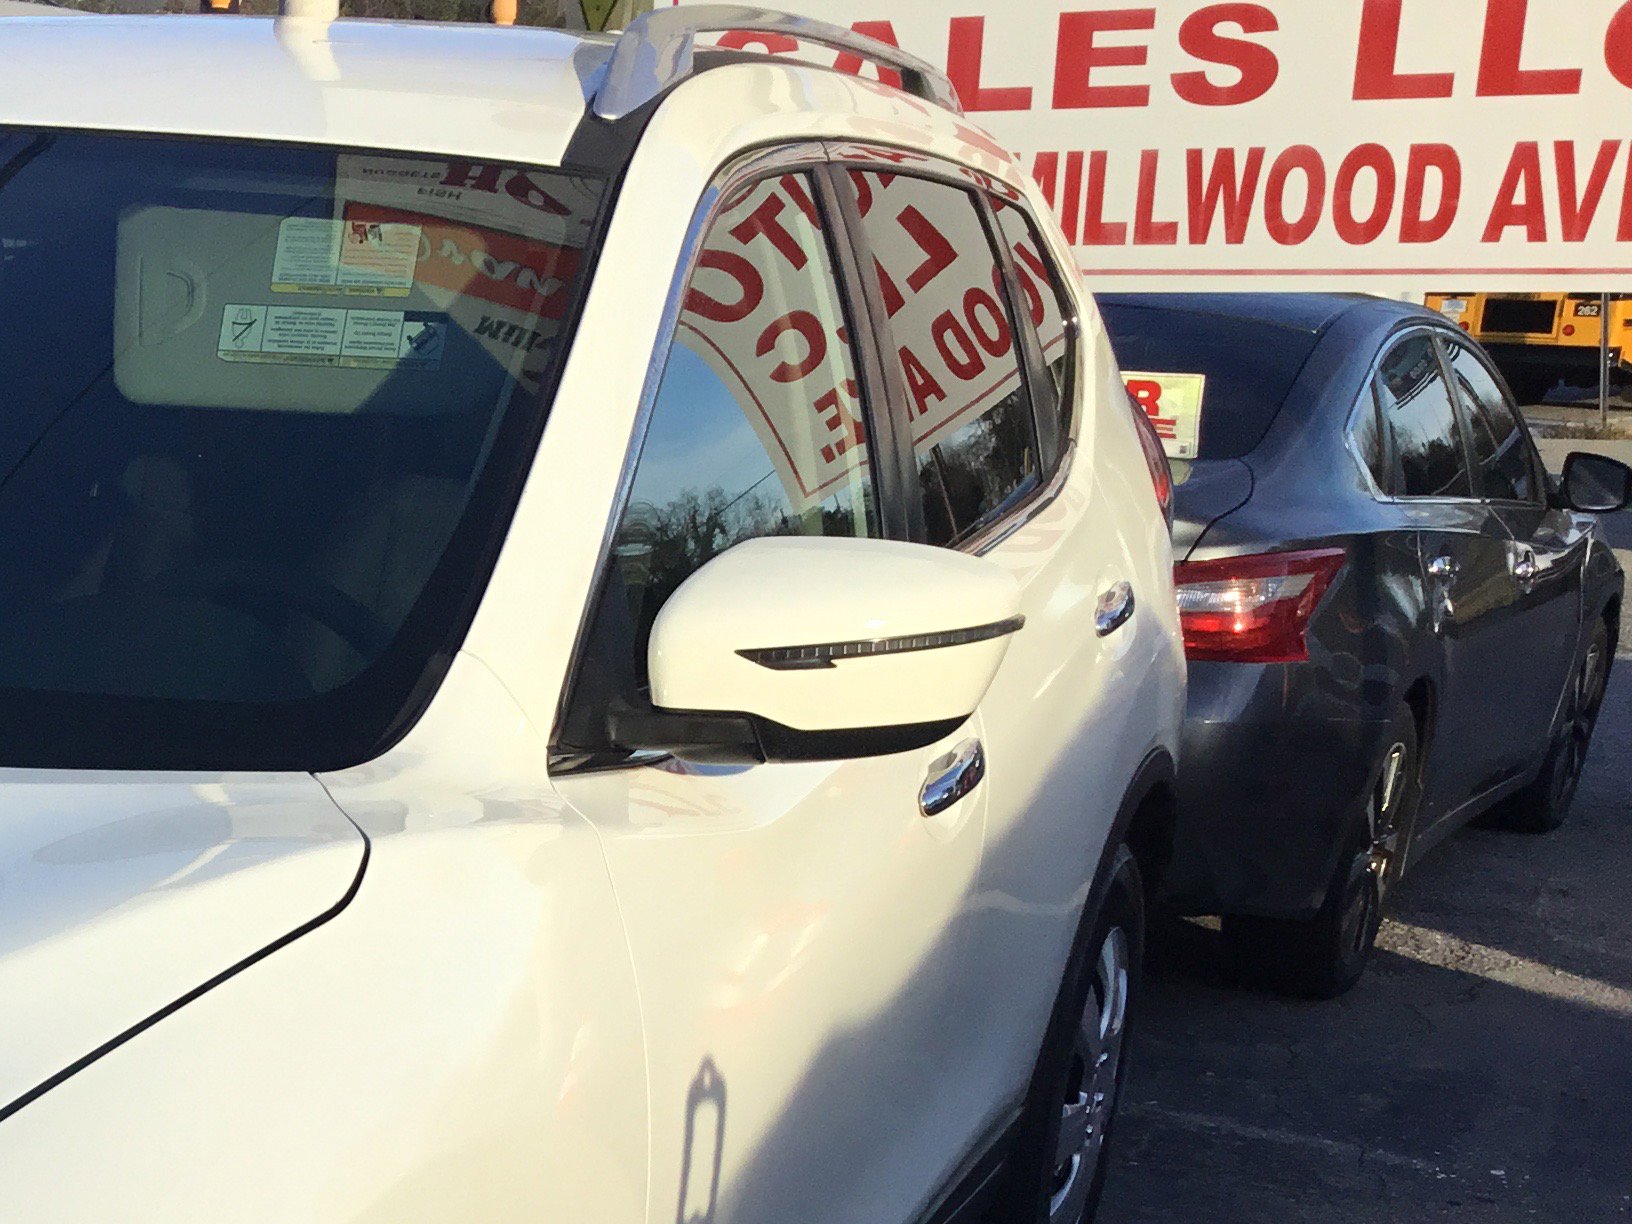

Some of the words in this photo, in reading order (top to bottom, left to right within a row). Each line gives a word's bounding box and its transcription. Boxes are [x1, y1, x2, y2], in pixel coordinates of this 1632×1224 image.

[716, 2, 1280, 112] ALES
[1351, 0, 1632, 101] LL
[1479, 138, 1632, 243] AV
[1577, 305, 1598, 316] 262
